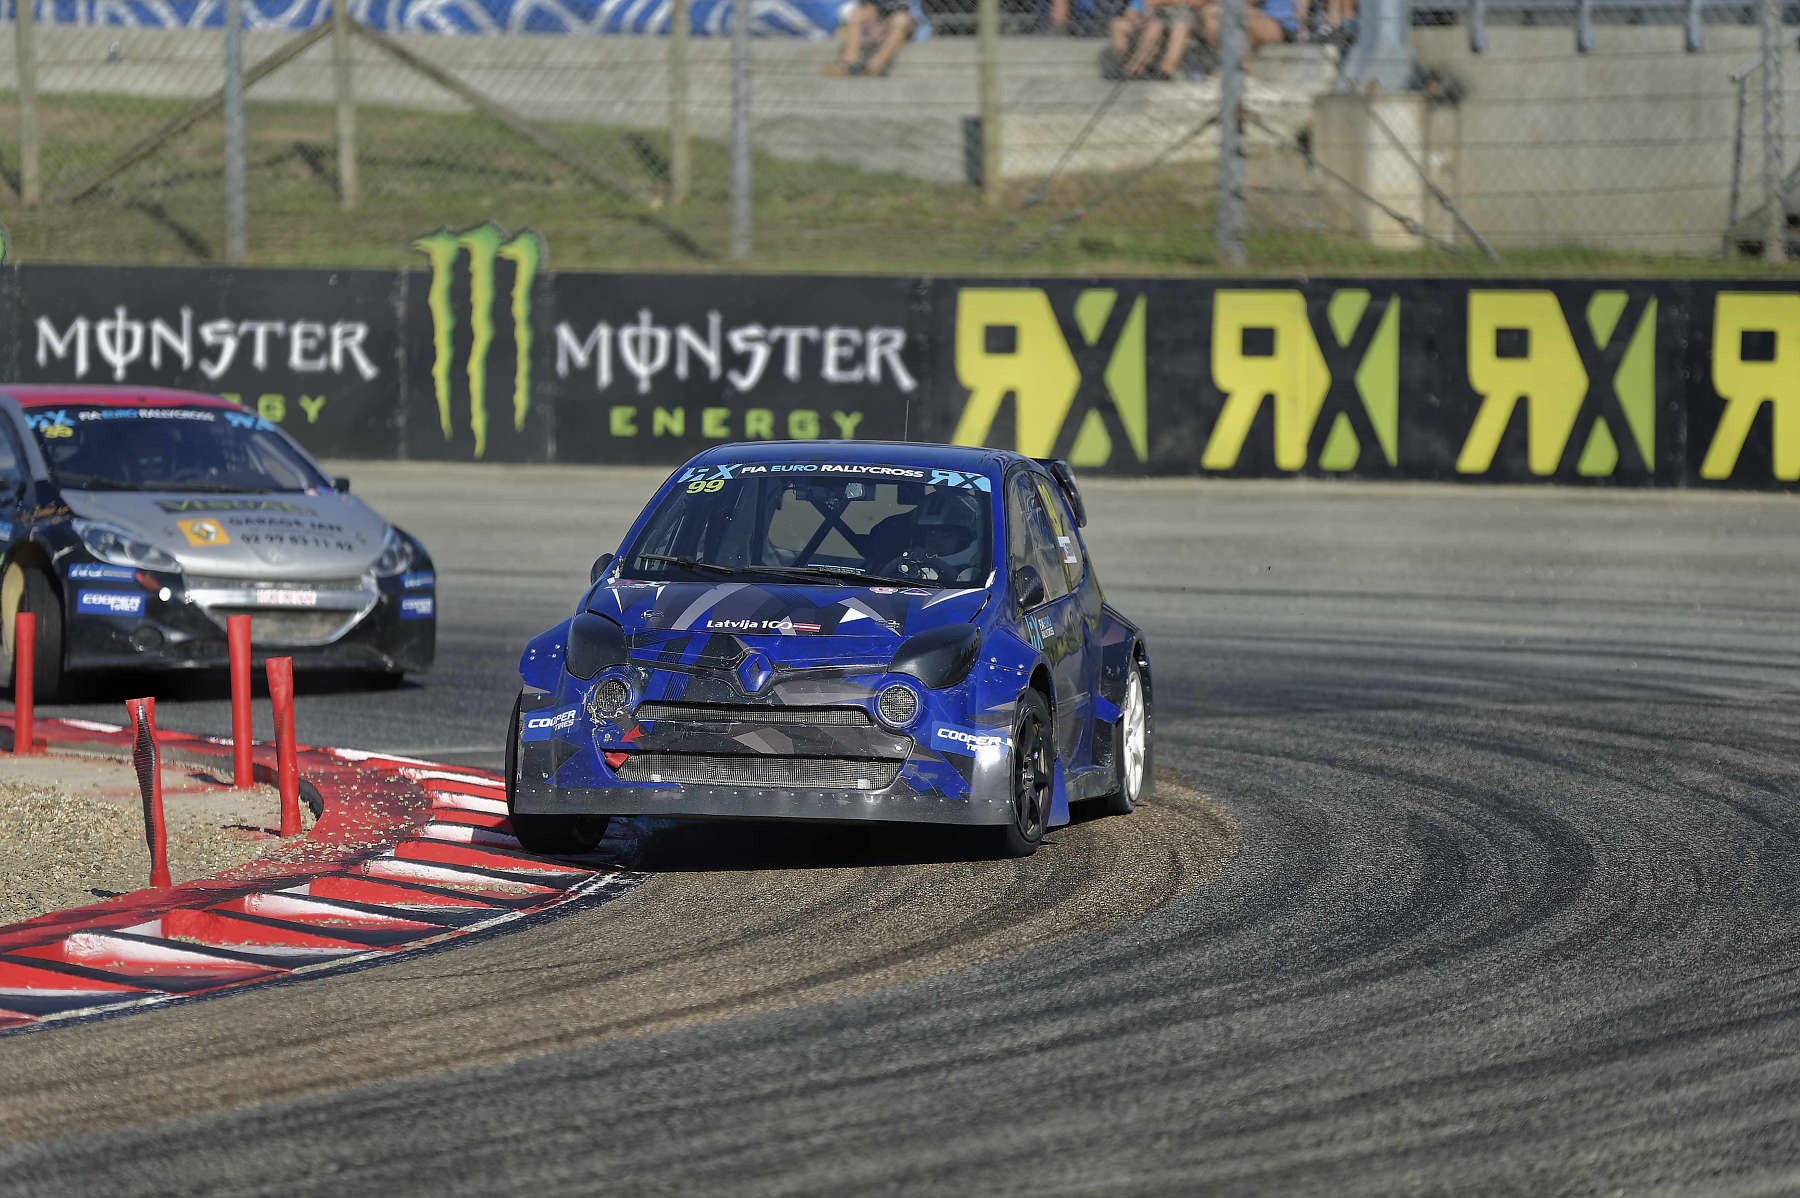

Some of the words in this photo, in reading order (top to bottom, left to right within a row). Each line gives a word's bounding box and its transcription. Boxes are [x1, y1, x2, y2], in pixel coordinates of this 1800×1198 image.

[34, 305, 379, 380] MONSTER
[554, 307, 918, 393] MONSTER
[1201, 288, 1398, 471] RX
[1455, 289, 1658, 476] RX
[609, 406, 863, 439] ENERGY
[741, 466, 767, 474] FIA
[771, 464, 818, 473] EURO
[820, 464, 924, 478] RALLYCROSS
[686, 479, 726, 494] 99
[706, 618, 758, 630] Latvija
[528, 709, 577, 729] COOPER
[937, 728, 1003, 747] COOPER
